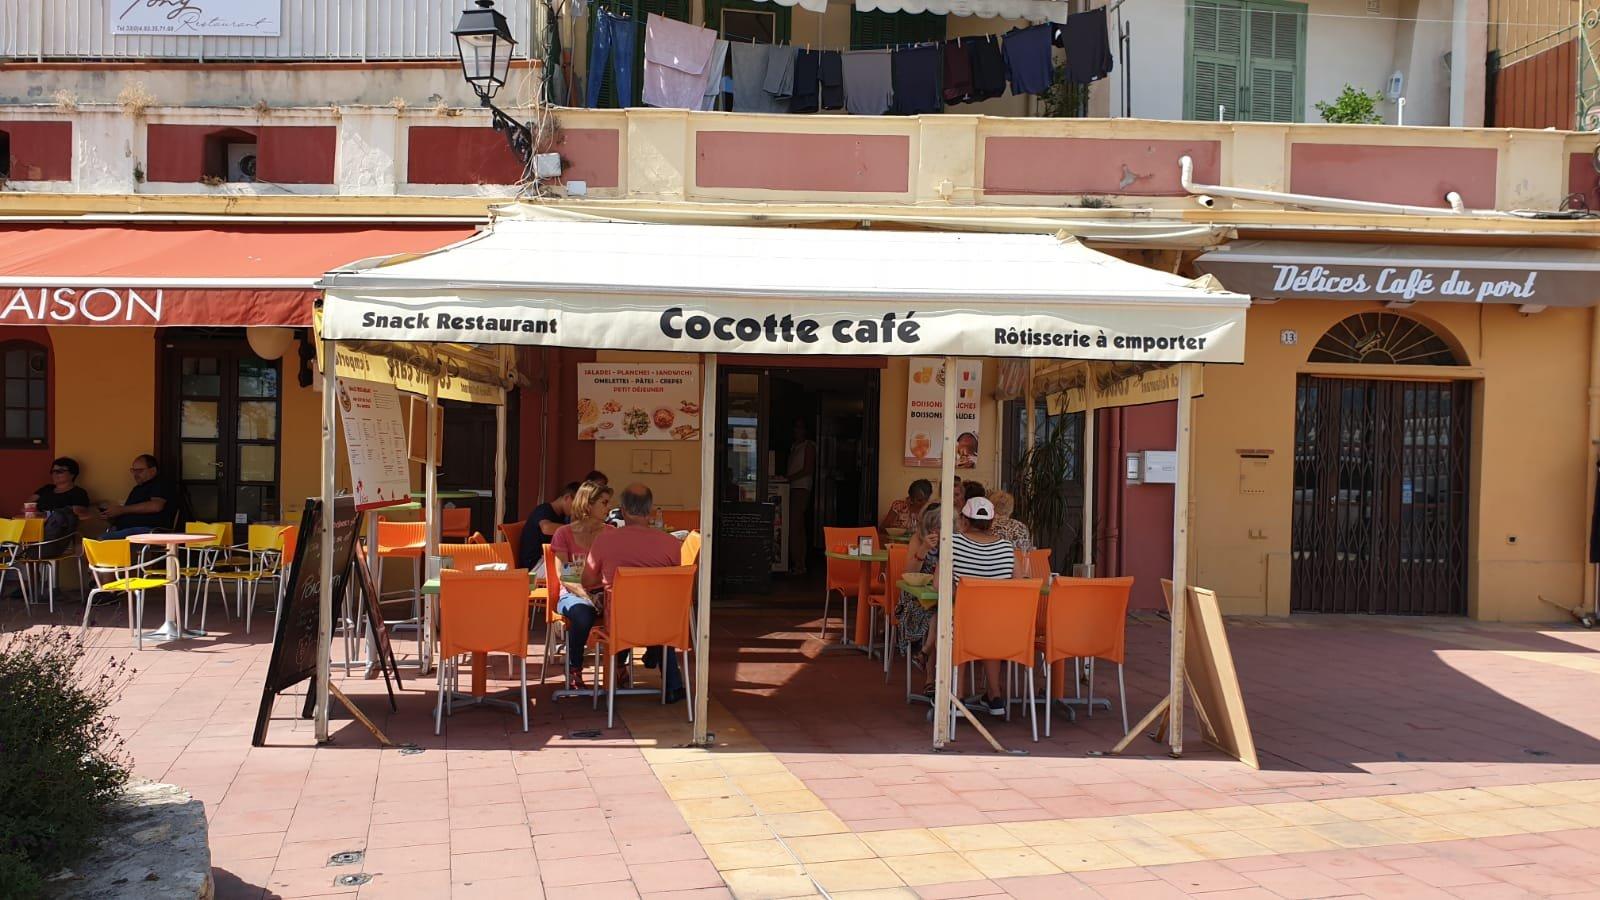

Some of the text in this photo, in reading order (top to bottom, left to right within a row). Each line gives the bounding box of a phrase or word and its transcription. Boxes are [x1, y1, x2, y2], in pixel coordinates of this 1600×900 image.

[174, 11, 272, 32] Restaurant
[1272, 264, 1538, 302] Délices Café du port
[0, 287, 163, 322] AISON
[362, 311, 557, 334] Snack Restaurant
[659, 307, 921, 343] Cocotte café
[994, 326, 1206, 353] Rôtisserie à emporter
[1285, 332, 1295, 342] 13
[910, 411, 943, 419] BOISSONS
[911, 400, 943, 408] BOISSONS
